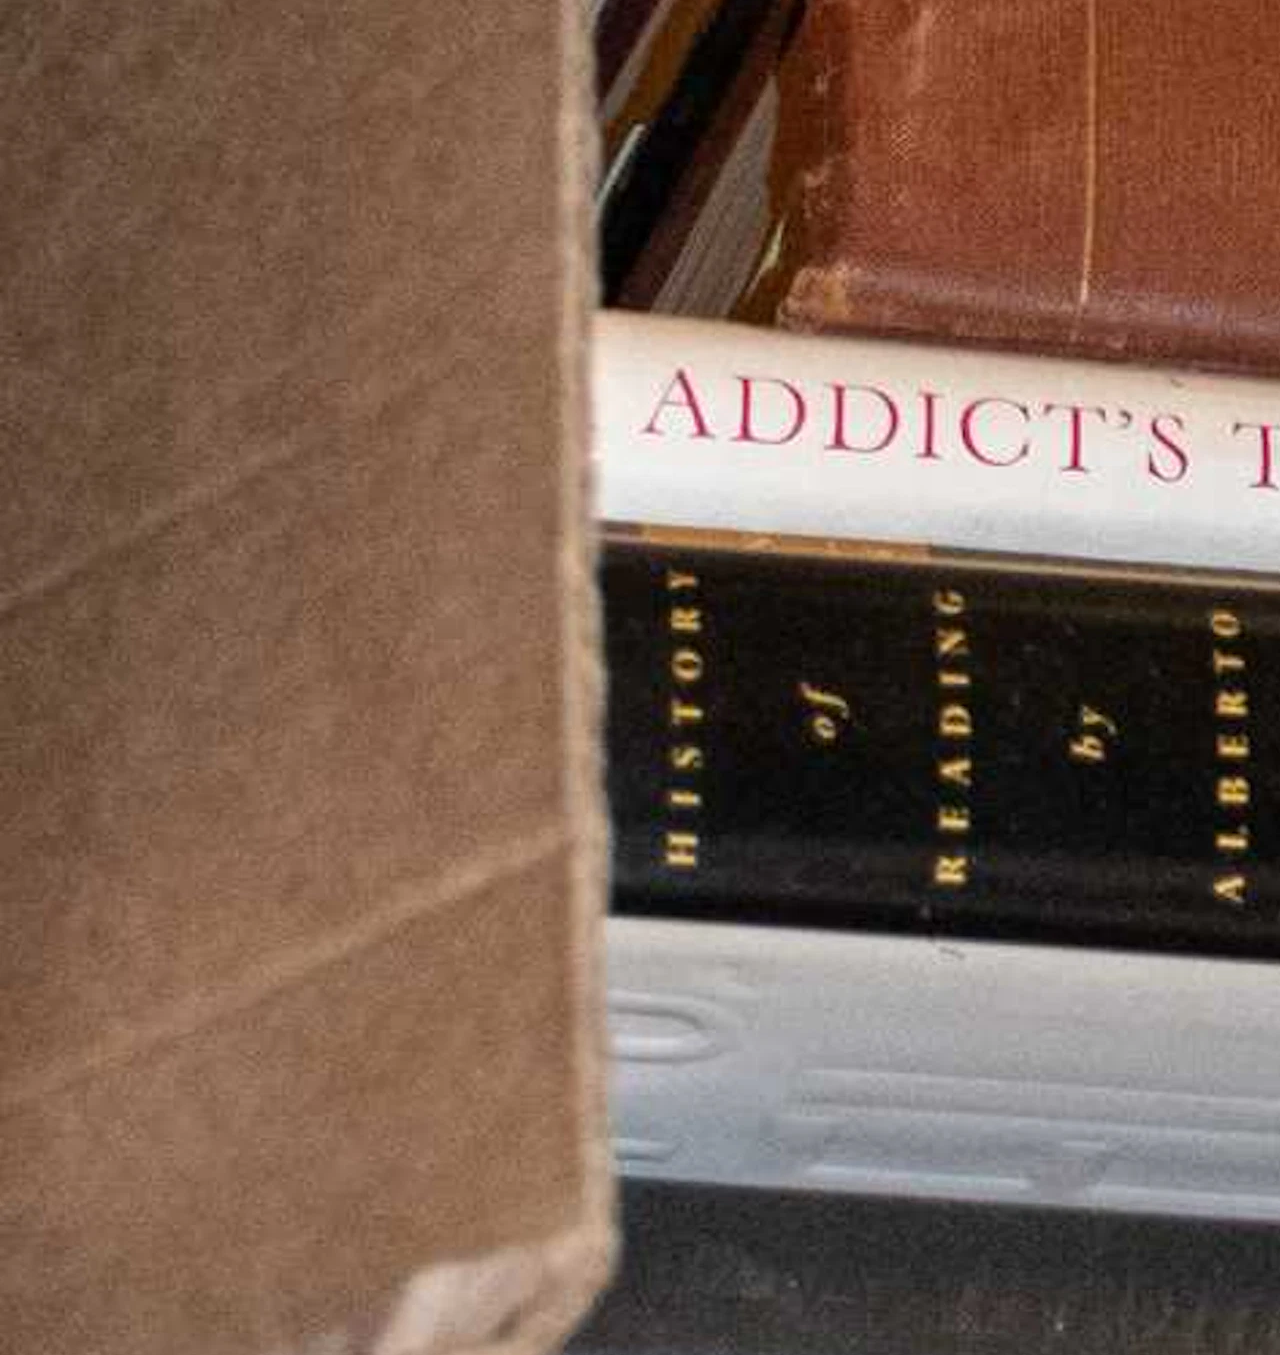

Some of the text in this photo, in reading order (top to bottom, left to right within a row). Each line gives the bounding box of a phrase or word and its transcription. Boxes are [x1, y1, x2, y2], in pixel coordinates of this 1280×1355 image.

[665, 570, 702, 868] HISTORY
[799, 683, 849, 740] of
[934, 590, 972, 885] READING
[1069, 705, 1118, 763] by
[1211, 608, 1250, 905] ALBERTO
